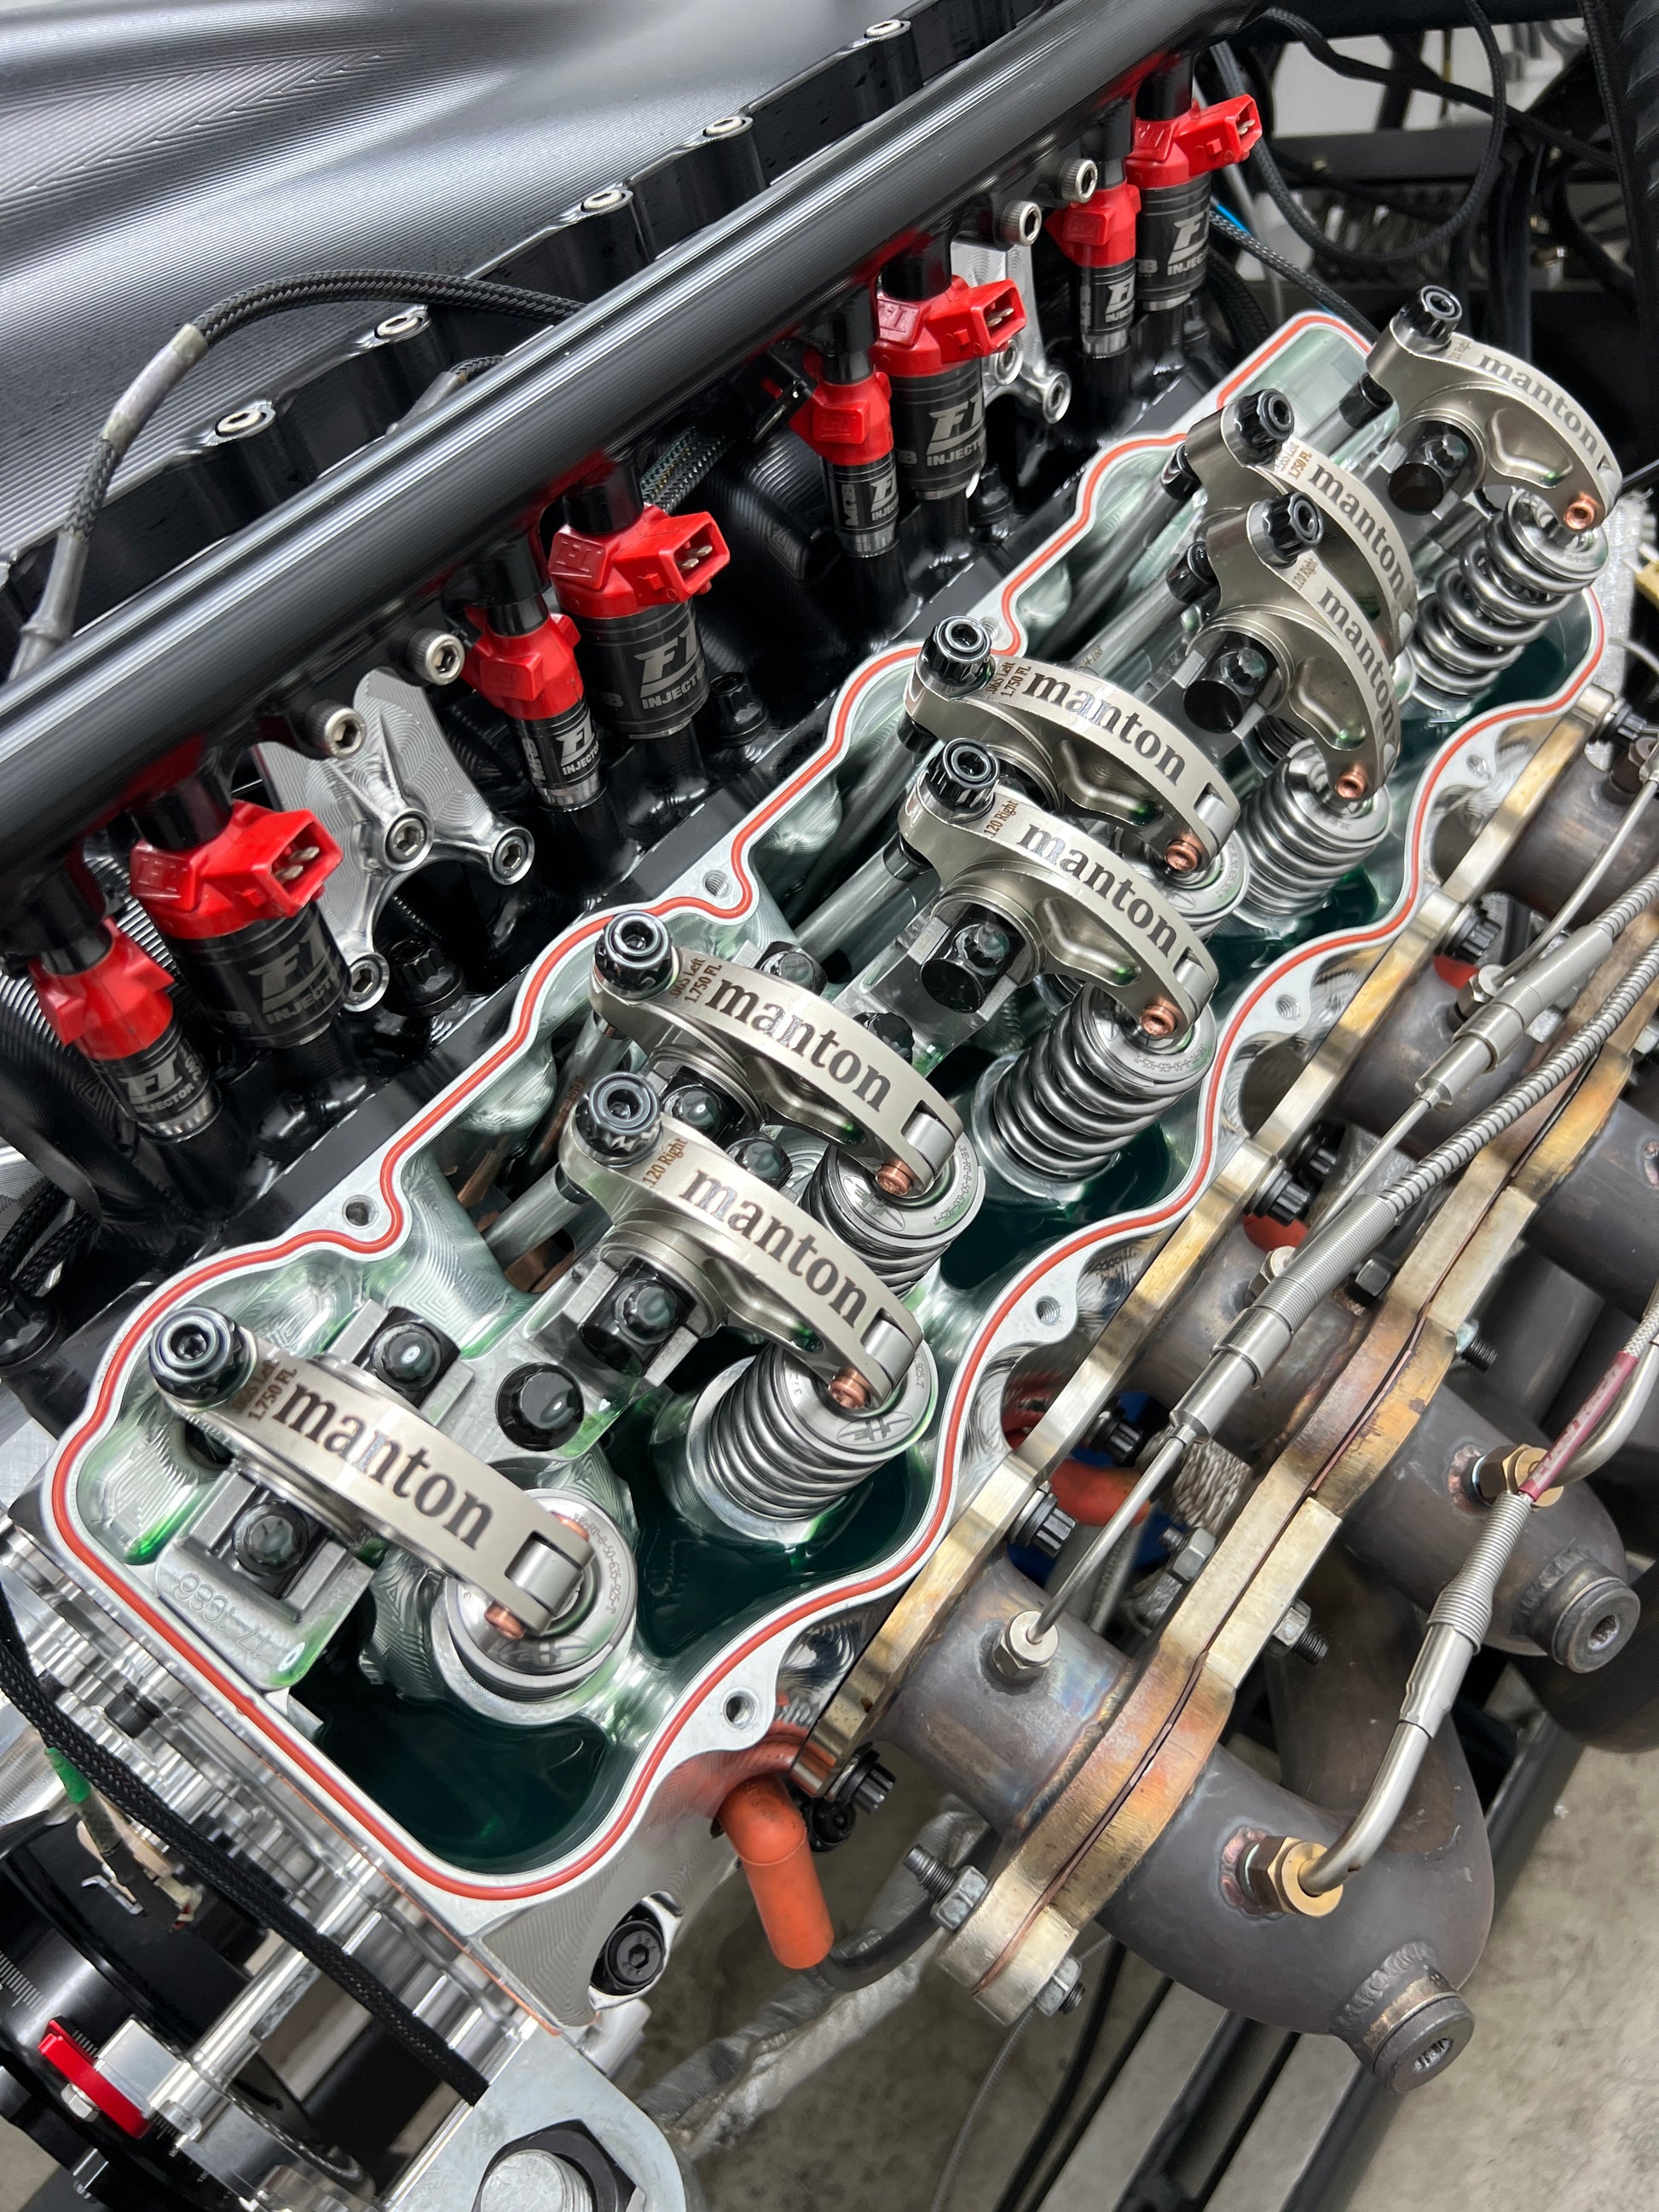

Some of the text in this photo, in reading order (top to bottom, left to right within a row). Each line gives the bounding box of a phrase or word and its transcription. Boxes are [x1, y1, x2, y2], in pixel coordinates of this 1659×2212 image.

[1167, 251, 1208, 276] INJEC
[1476, 355, 1598, 457] manton
[1299, 451, 1313, 465] FL
[1307, 463, 1406, 597] manton
[1299, 557, 1318, 580] Right
[998, 661, 1016, 679] Left
[1000, 665, 1032, 698] 1.750 FL
[1316, 586, 1395, 735] manton
[1023, 673, 1186, 787] manton
[995, 800, 1020, 822] Right
[1016, 823, 1177, 958] manton
[685, 957, 706, 977] Left
[685, 964, 723, 1004] 1.750 FL
[705, 979, 891, 1112] manton
[660, 1137, 689, 1168] Right
[679, 1169, 868, 1329] manton
[248, 1367, 298, 1422] 1.750 FL
[272, 1382, 494, 1551] manton
[176, 1573, 273, 1659] 17-1086
